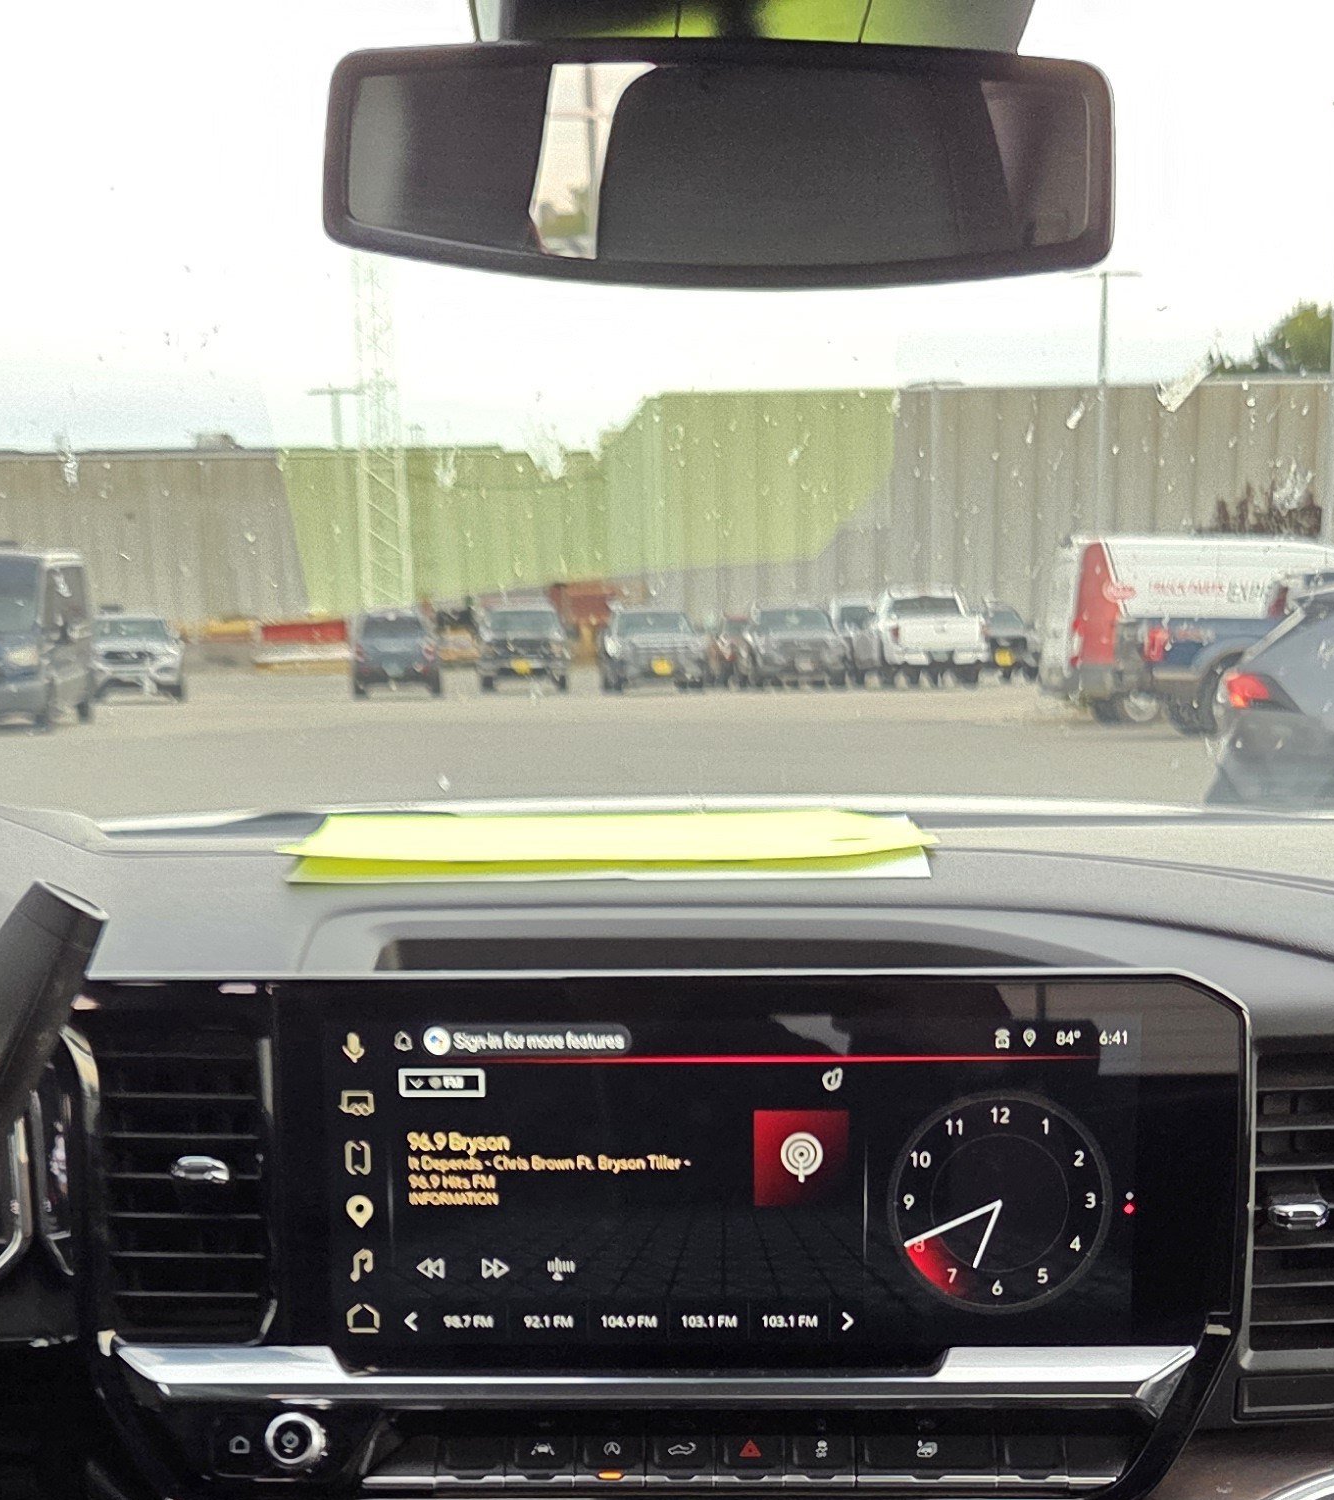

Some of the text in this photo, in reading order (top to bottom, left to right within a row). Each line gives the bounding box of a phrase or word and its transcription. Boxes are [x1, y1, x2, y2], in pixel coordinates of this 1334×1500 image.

[503, 1031, 525, 1050] for
[526, 1034, 565, 1050] more
[566, 1031, 625, 1050] features
[1098, 1029, 1128, 1046] 6:41
[990, 1106, 1010, 1124] 12
[945, 1117, 964, 1136] 11
[1041, 1117, 1050, 1135] 1
[448, 1131, 510, 1157] Bryson
[421, 1155, 484, 1173] Depends
[493, 1154, 530, 1171] Chris
[531, 1155, 575, 1171] Brown
[597, 1154, 646, 1174] Bryson
[646, 1154, 682, 1171] Tiller
[910, 1150, 932, 1168] 10
[1073, 1149, 1085, 1167] 2
[472, 1174, 496, 1189] FM
[408, 1191, 499, 1206] INFORMATION
[903, 1193, 915, 1211] 9
[1084, 1191, 1097, 1209] 3
[1069, 1234, 1082, 1252] 4
[946, 1267, 958, 1284] 7
[1037, 1267, 1049, 1285] 5
[991, 1279, 1003, 1296] 6
[473, 1314, 495, 1329] FM
[552, 1314, 574, 1329] FM
[637, 1314, 658, 1329] FM
[681, 1314, 738, 1329] 103.1 FM
[761, 1314, 819, 1329] 103.1 FM
